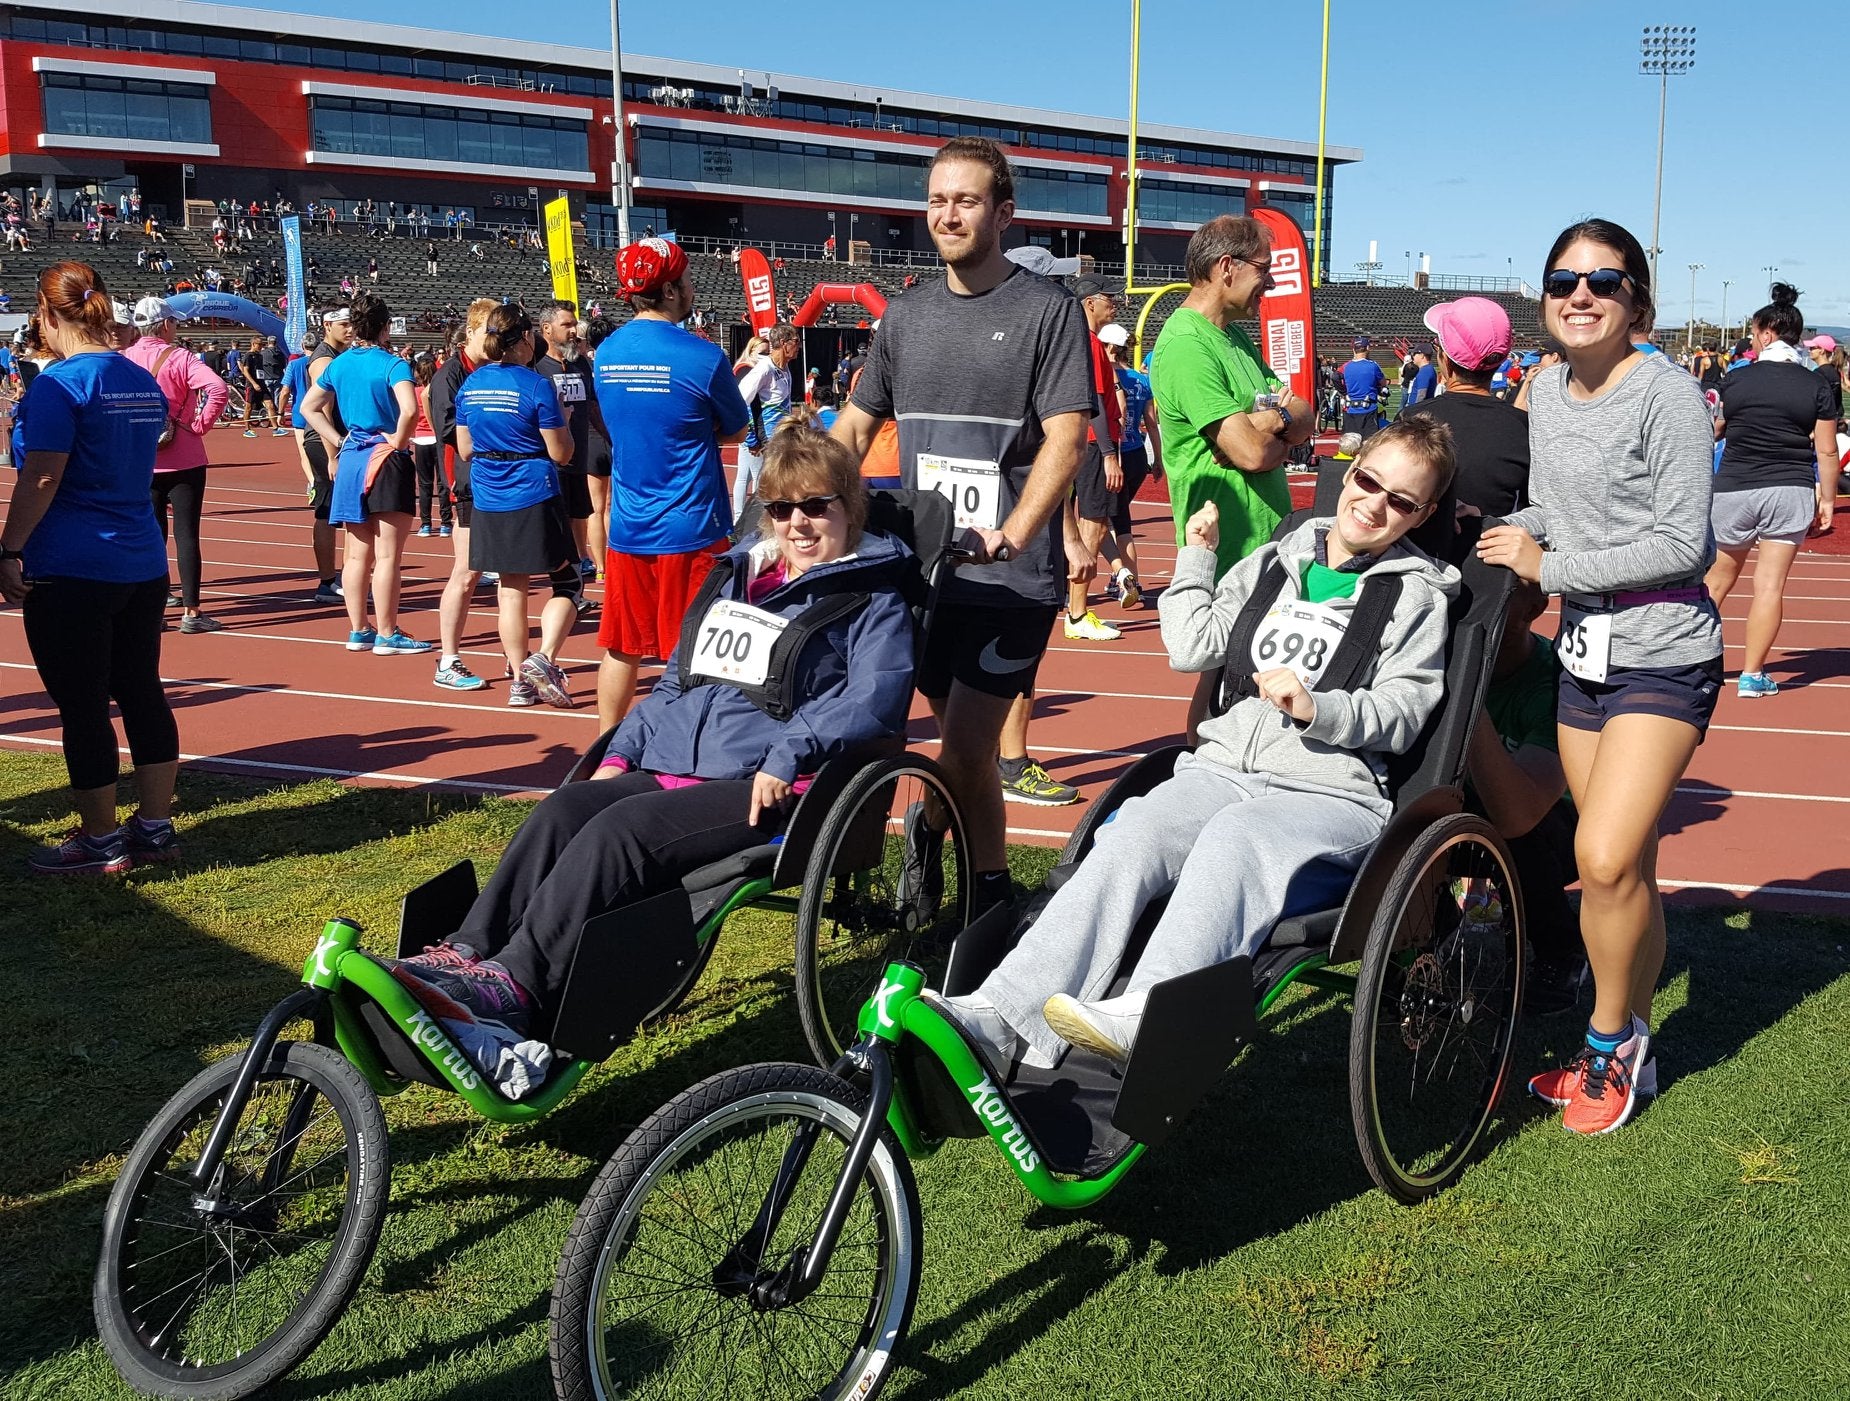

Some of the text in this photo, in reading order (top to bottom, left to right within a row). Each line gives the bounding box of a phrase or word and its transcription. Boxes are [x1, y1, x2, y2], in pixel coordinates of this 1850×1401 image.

[1271, 321, 1287, 371] JOURNAL
[561, 383, 579, 396] 577
[700, 627, 752, 663] 700
[1259, 628, 1328, 671] 698
[406, 1008, 482, 1090] Kartus
[967, 1067, 1040, 1173] Kartus
[849, 1370, 876, 1401] COM
